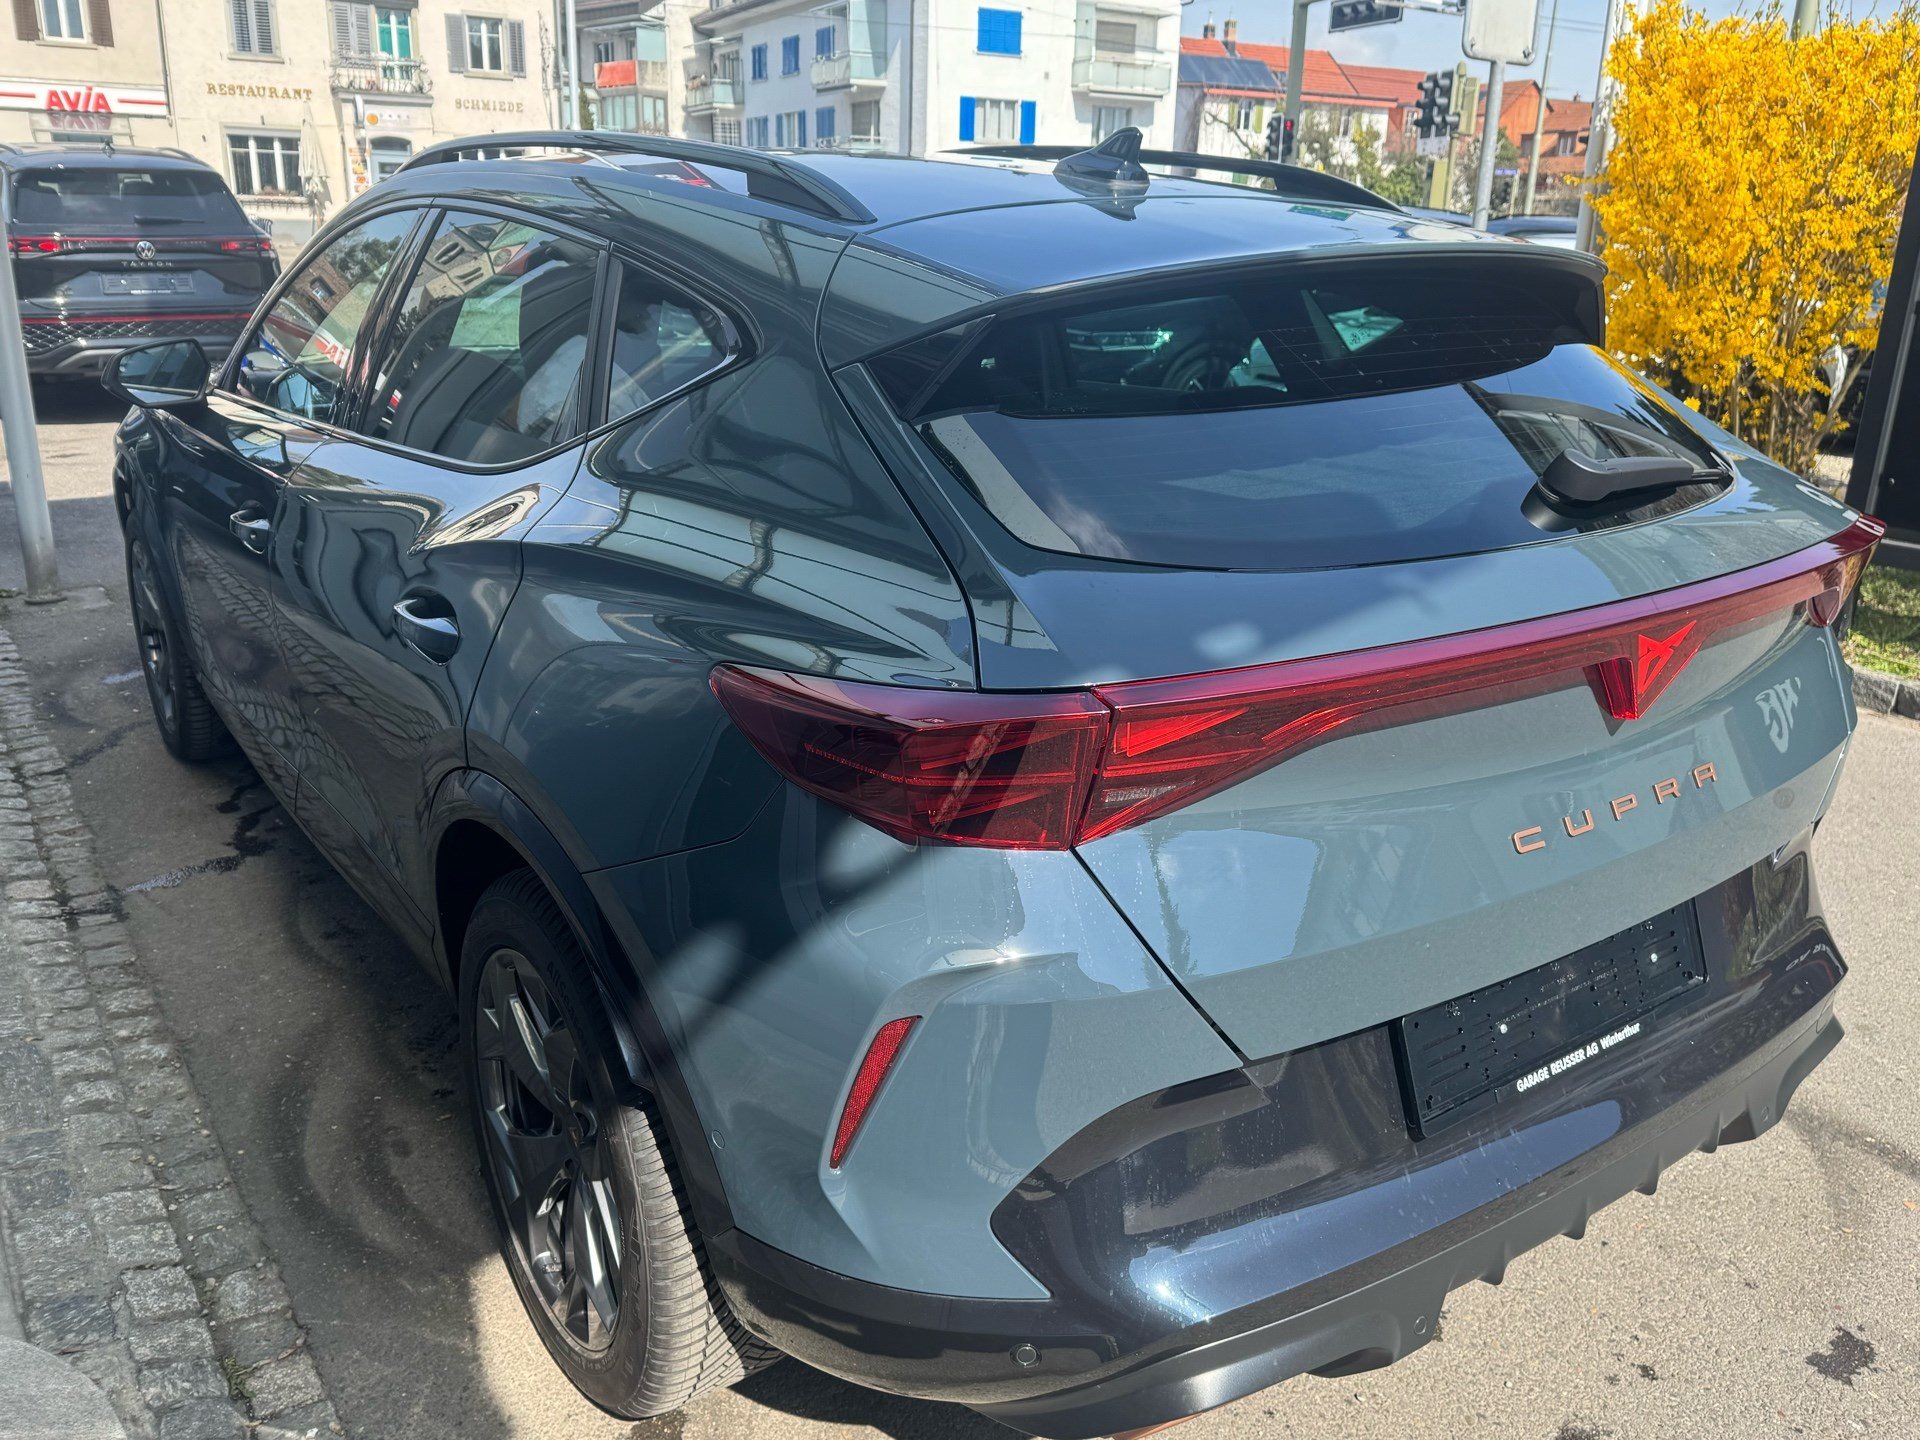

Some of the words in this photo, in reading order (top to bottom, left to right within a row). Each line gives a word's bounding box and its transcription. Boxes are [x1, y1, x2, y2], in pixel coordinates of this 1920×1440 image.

[206, 82, 312, 101] RESTAURANT
[454, 98, 524, 113] SCHMIEDE
[1511, 762, 1717, 855] CUPRA
[1516, 1066, 1550, 1092] GARAGE
[1550, 1048, 1586, 1076] REUSSER
[1586, 1041, 1600, 1058] AG
[1600, 1022, 1640, 1049] Winterthur
